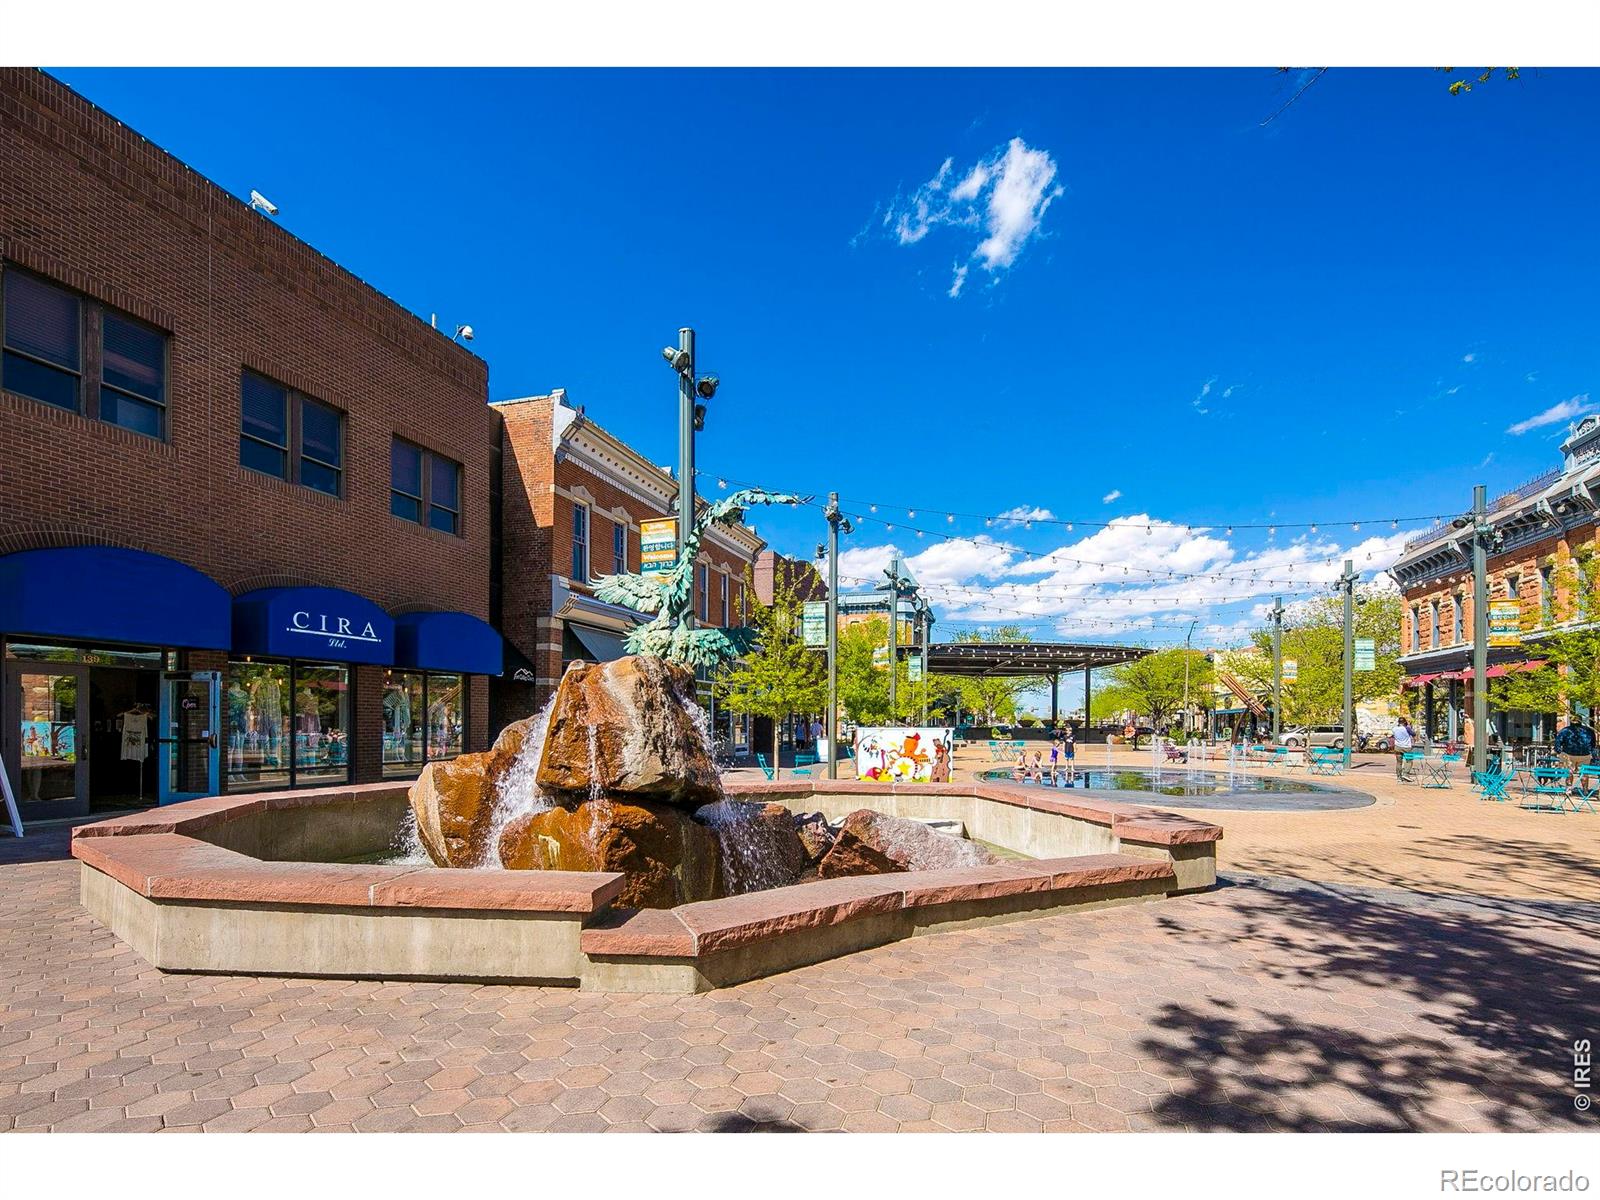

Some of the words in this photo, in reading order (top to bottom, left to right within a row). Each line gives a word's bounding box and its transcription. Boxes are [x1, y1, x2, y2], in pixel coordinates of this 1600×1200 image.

[293, 611, 377, 638] CIRA
[328, 638, 347, 648] Ltd.
[82, 655, 100, 665] 139
